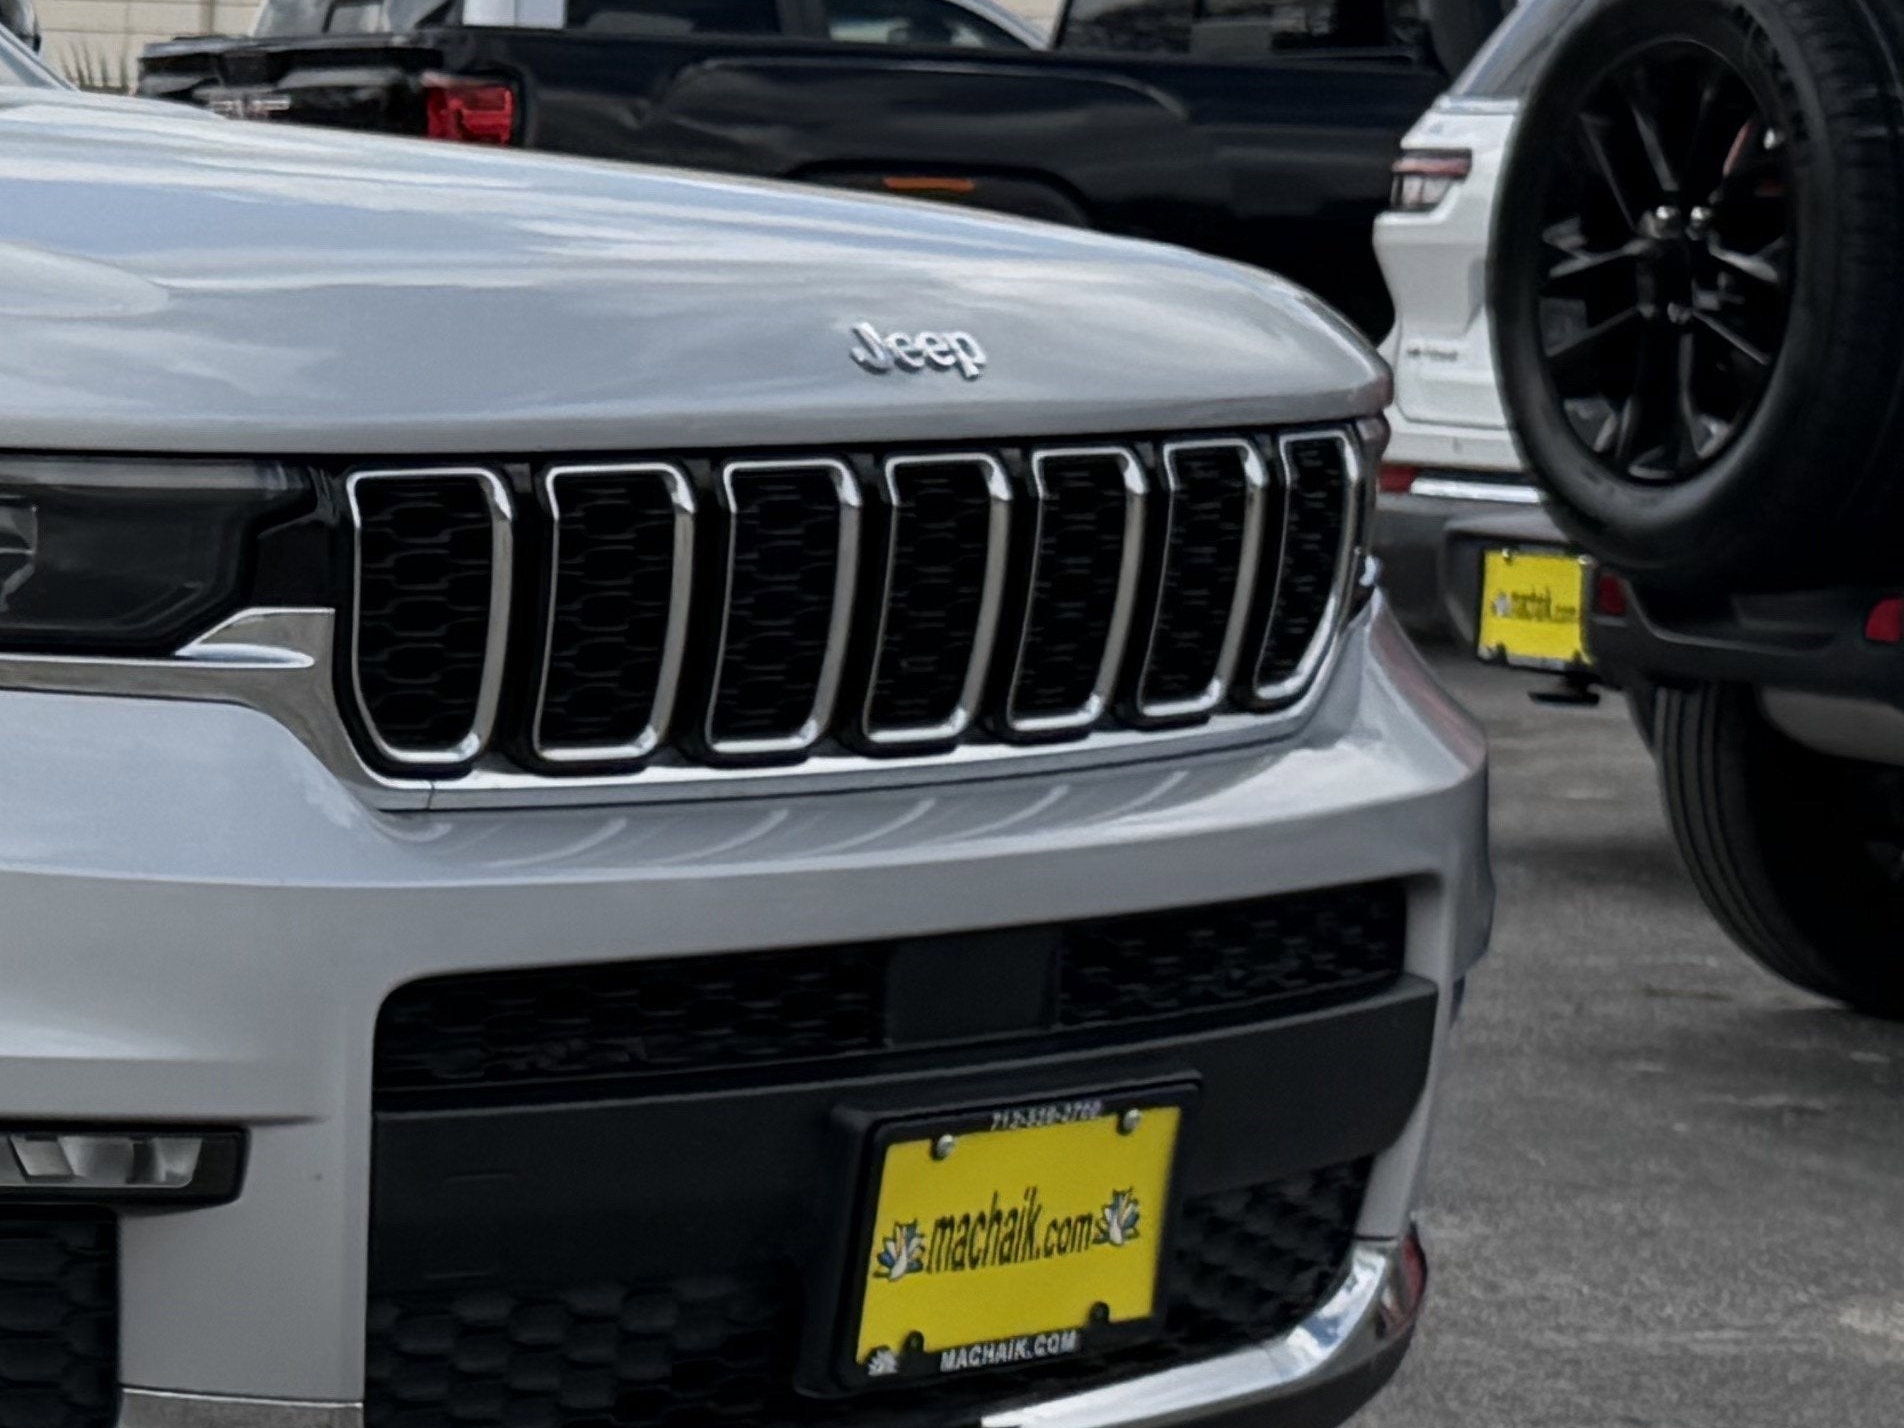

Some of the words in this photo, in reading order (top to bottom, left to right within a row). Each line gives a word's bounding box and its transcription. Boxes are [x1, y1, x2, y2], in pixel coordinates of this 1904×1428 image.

[849, 321, 988, 381] Jeep
[926, 1185, 1094, 1275] machaik.com
[939, 1329, 1078, 1373] MACHAIK.COM
